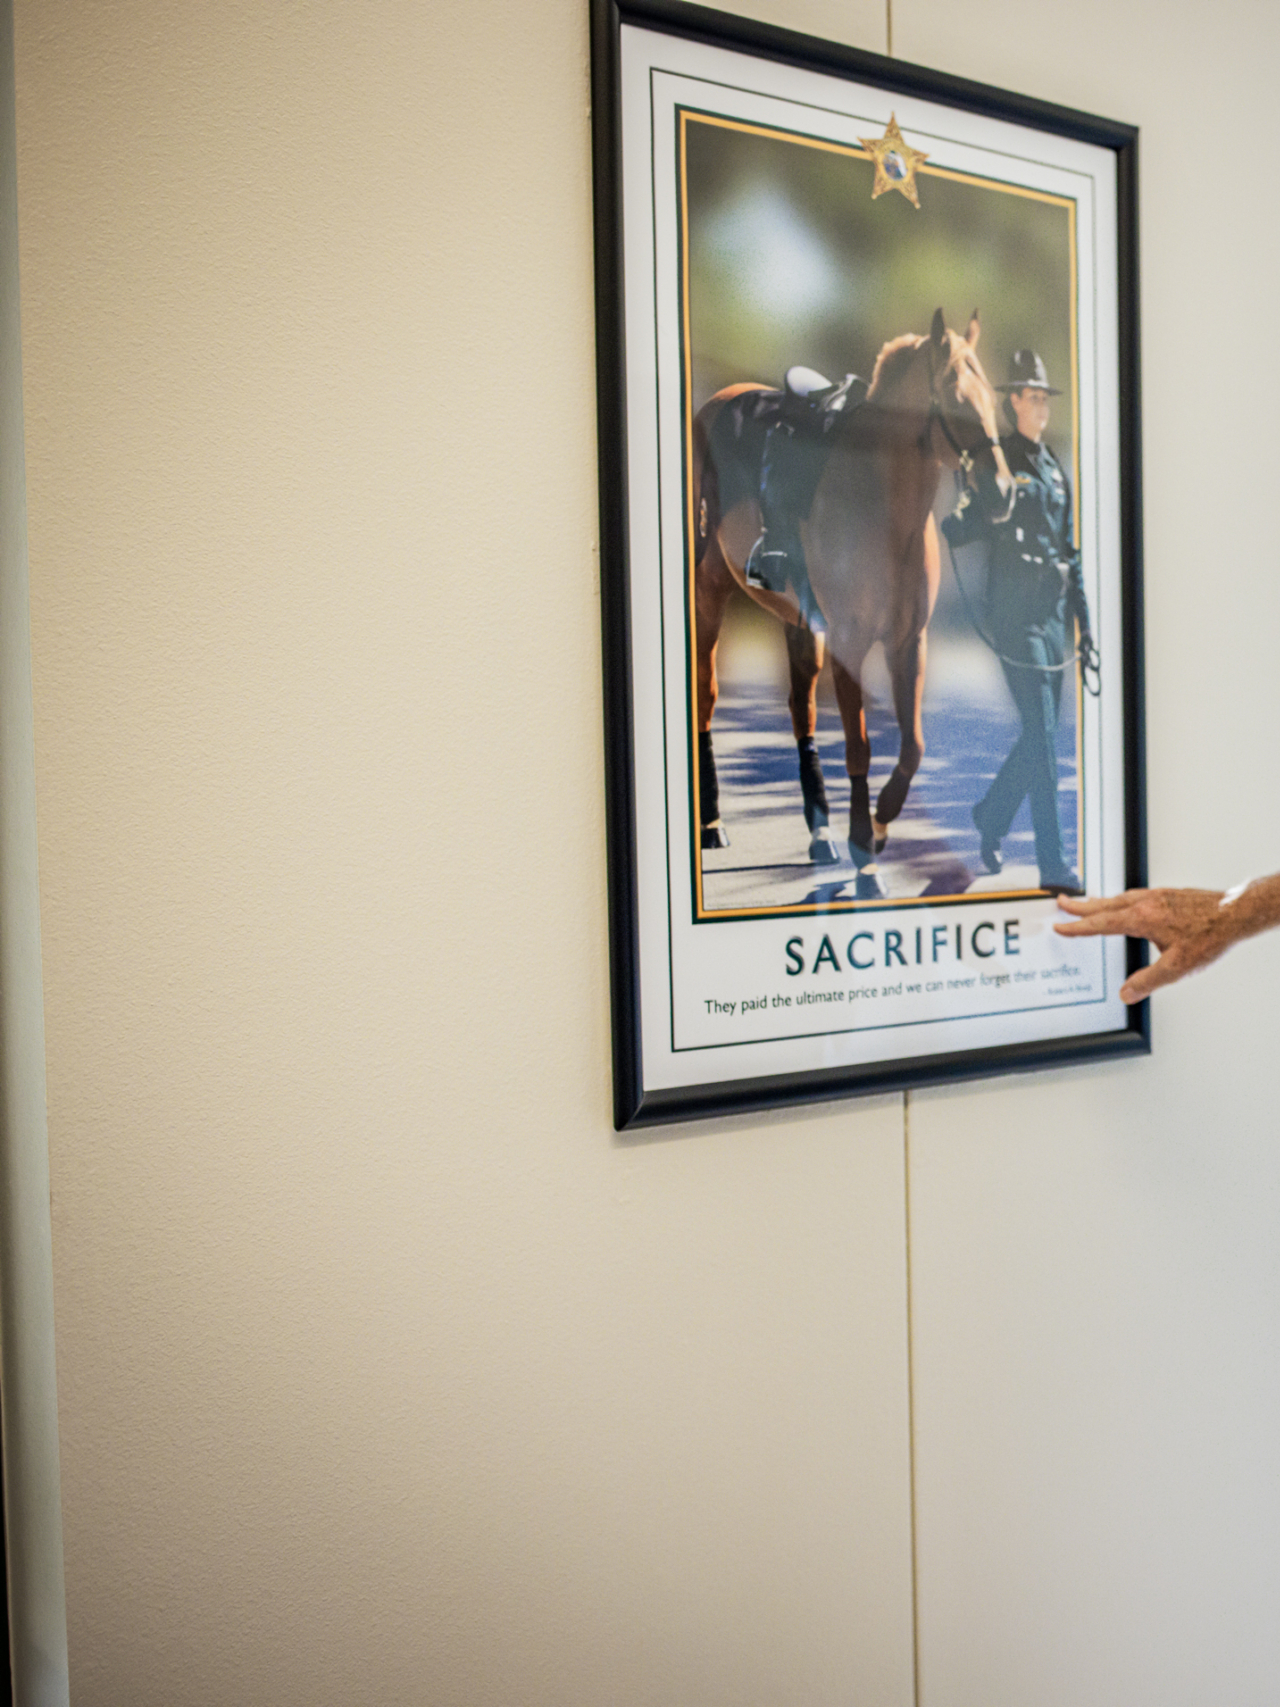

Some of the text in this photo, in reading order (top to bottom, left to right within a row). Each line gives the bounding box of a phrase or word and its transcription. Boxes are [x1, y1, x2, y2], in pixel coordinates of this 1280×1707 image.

[785, 919, 1021, 977] SACRIFICE
[704, 1000, 737, 1017] They
[741, 996, 767, 1015] paid
[772, 994, 792, 1008] the
[796, 991, 844, 1006] ultimate
[848, 987, 878, 1003] price
[882, 982, 902, 997] and
[906, 984, 922, 994] we
[925, 980, 944, 993] can
[947, 976, 975, 990] never
[980, 972, 1011, 988] forget
[1013, 969, 1036, 982] their
